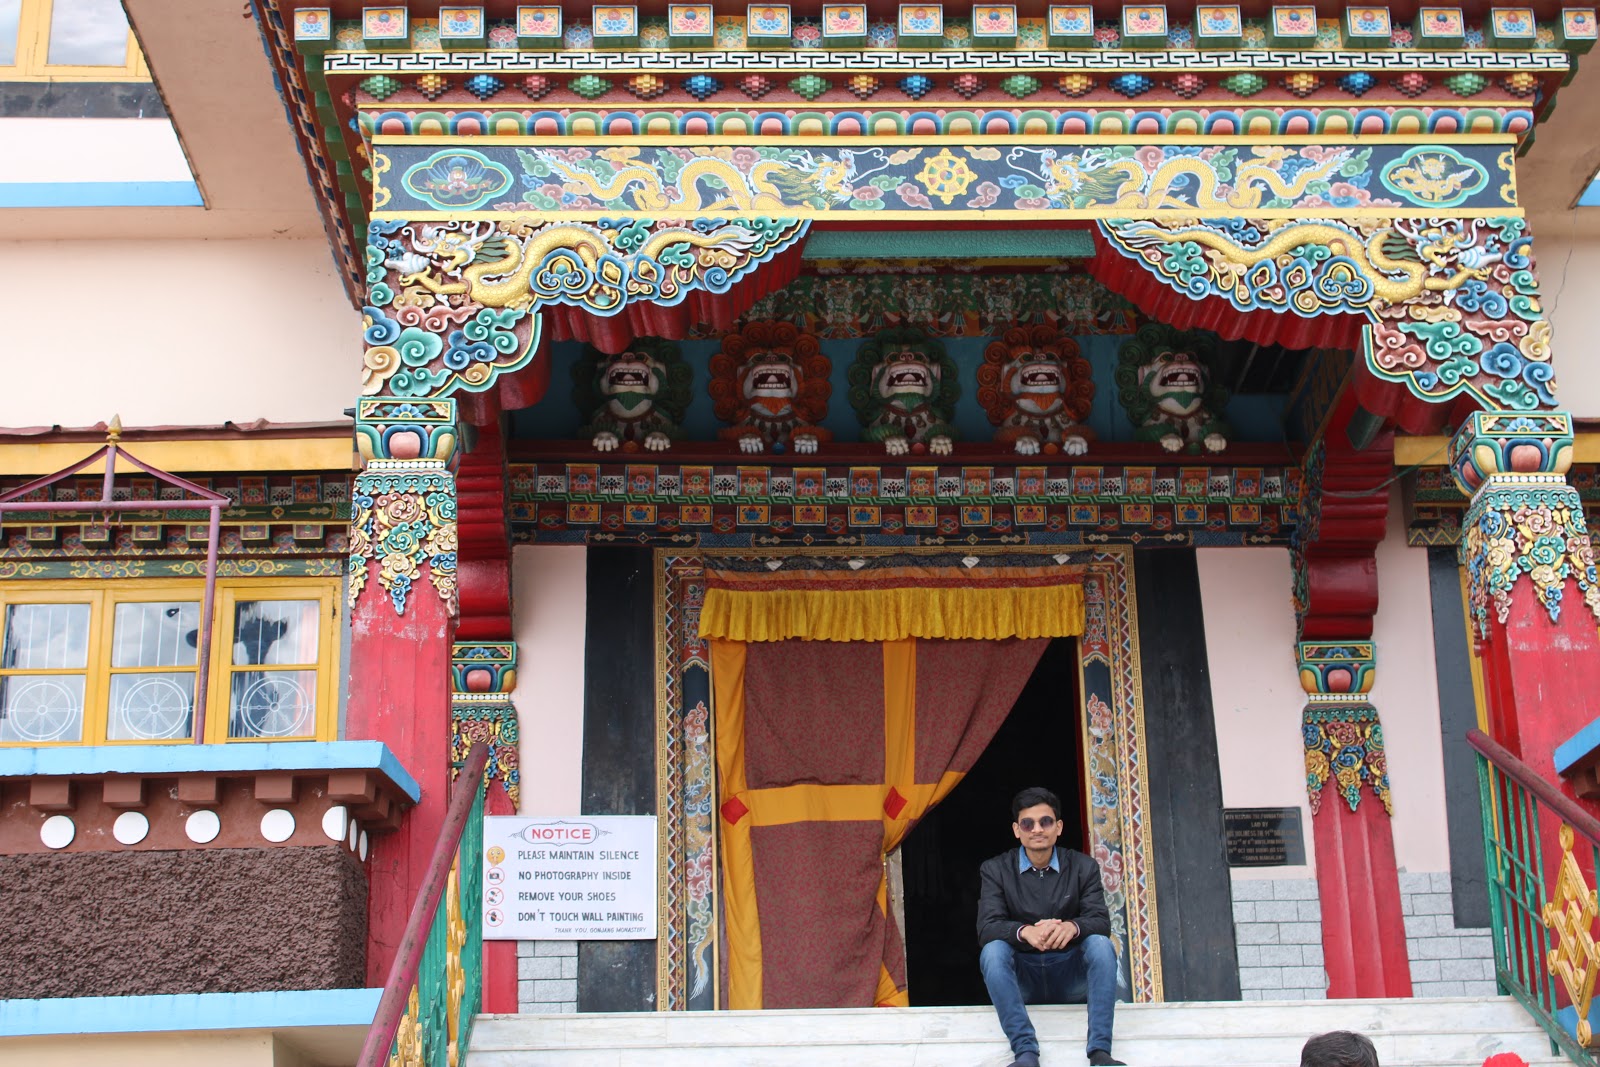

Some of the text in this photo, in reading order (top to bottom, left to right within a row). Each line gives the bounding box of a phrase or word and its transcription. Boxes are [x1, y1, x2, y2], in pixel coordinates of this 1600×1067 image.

[532, 828, 591, 840] NOTICE
[518, 850, 639, 860] PLEASE MAINTAIN SILENCE
[518, 871, 631, 880] NO PHOTOGRAPHY INSIDE
[518, 892, 616, 901] REMOVE YOUR SHOES
[518, 909, 643, 922] DON'T TOUCH WALL PAINTING
